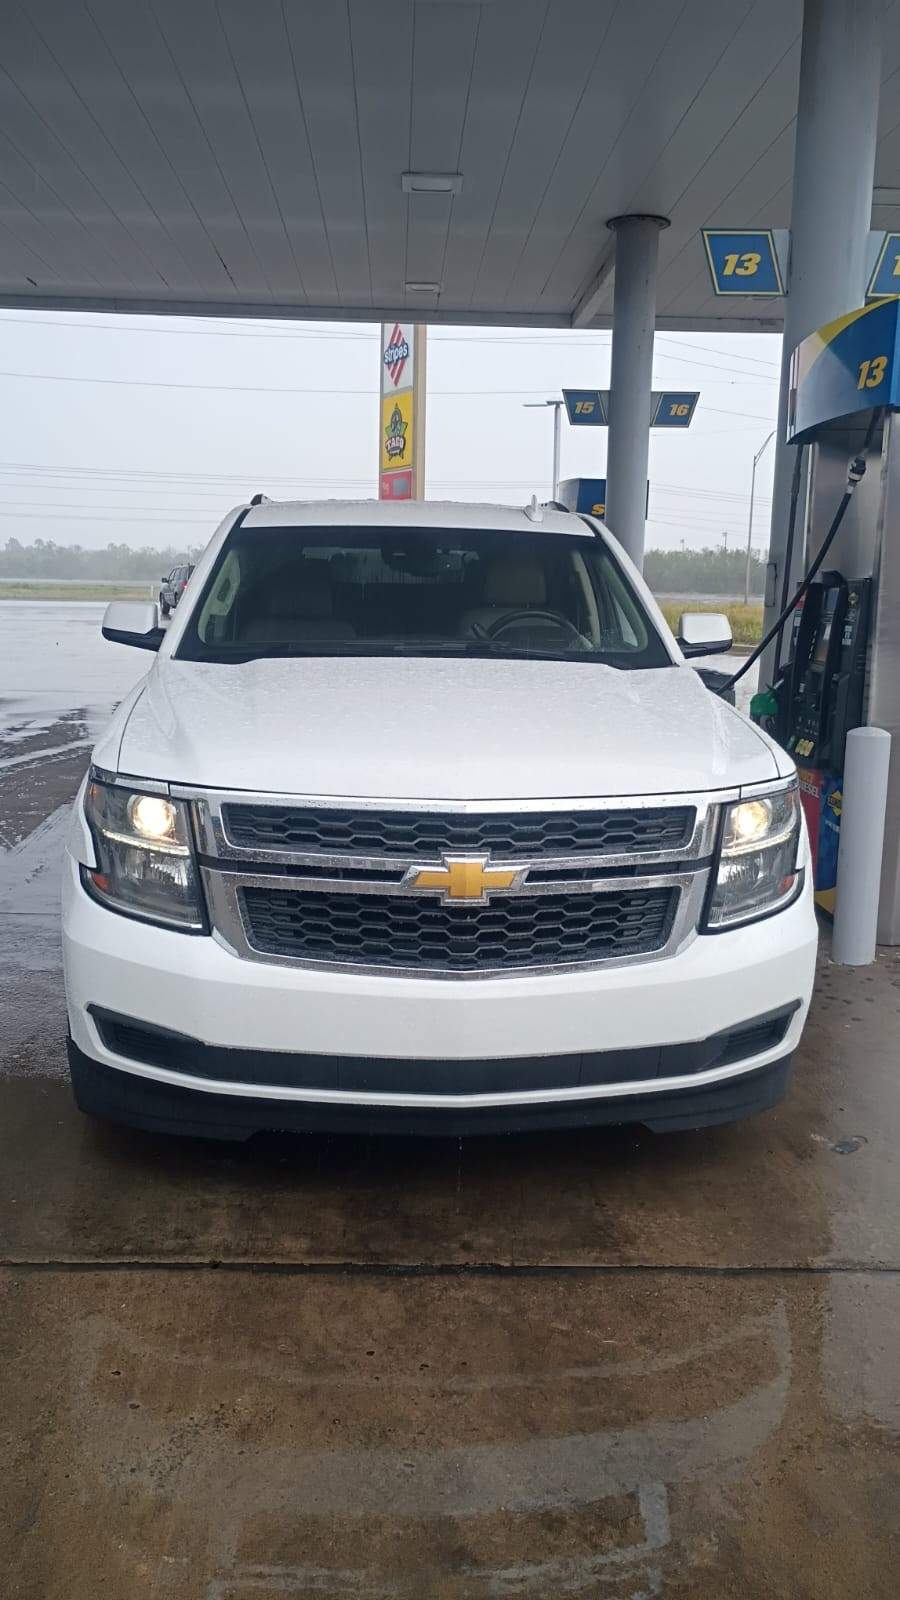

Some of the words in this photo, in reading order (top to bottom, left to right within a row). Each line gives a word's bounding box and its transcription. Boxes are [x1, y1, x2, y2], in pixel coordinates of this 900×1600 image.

[722, 252, 761, 276] 13
[384, 342, 408, 365] stripes
[856, 355, 888, 391] 13
[574, 401, 596, 414] 15
[668, 403, 690, 417] 16
[386, 437, 404, 450] TACO
